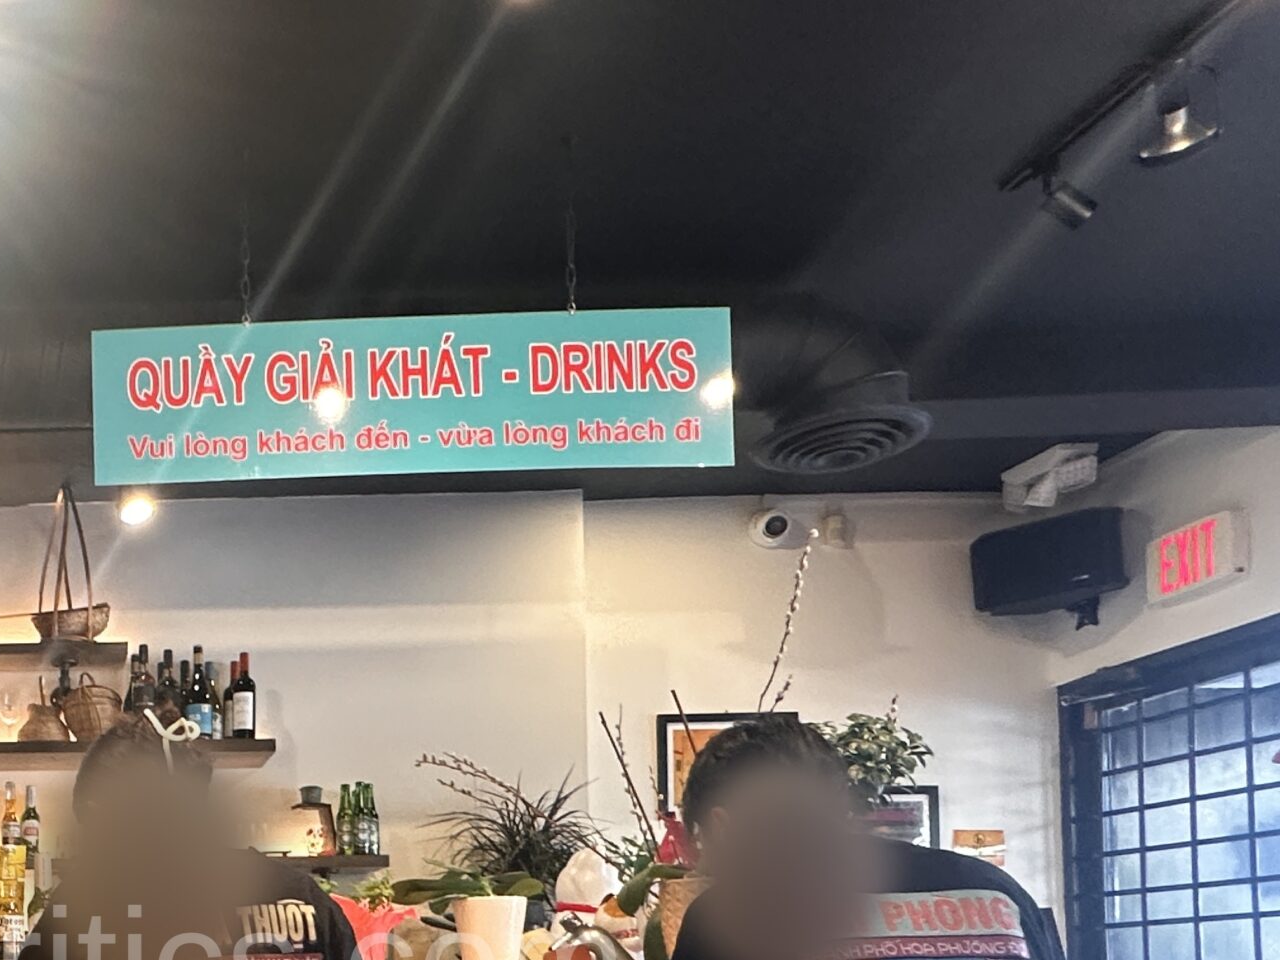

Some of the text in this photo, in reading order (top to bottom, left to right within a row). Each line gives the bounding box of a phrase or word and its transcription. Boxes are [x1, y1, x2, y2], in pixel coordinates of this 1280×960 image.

[127, 343, 255, 412] QUẦY
[264, 338, 354, 404] GIẢI
[366, 331, 490, 400] KHÁT
[528, 338, 698, 396] DRINKS
[128, 434, 175, 459] Vui
[184, 431, 248, 463] lòng
[257, 426, 346, 455] khách
[355, 419, 410, 451] đến
[436, 421, 495, 447] vừa
[503, 419, 568, 451] lòng
[577, 416, 665, 444] khách
[674, 417, 702, 442] đi
[1159, 518, 1218, 596] EXIT
[236, 898, 317, 949] THUỘT
[878, 893, 1017, 932] PHÒNG
[901, 943, 936, 955] HOA
